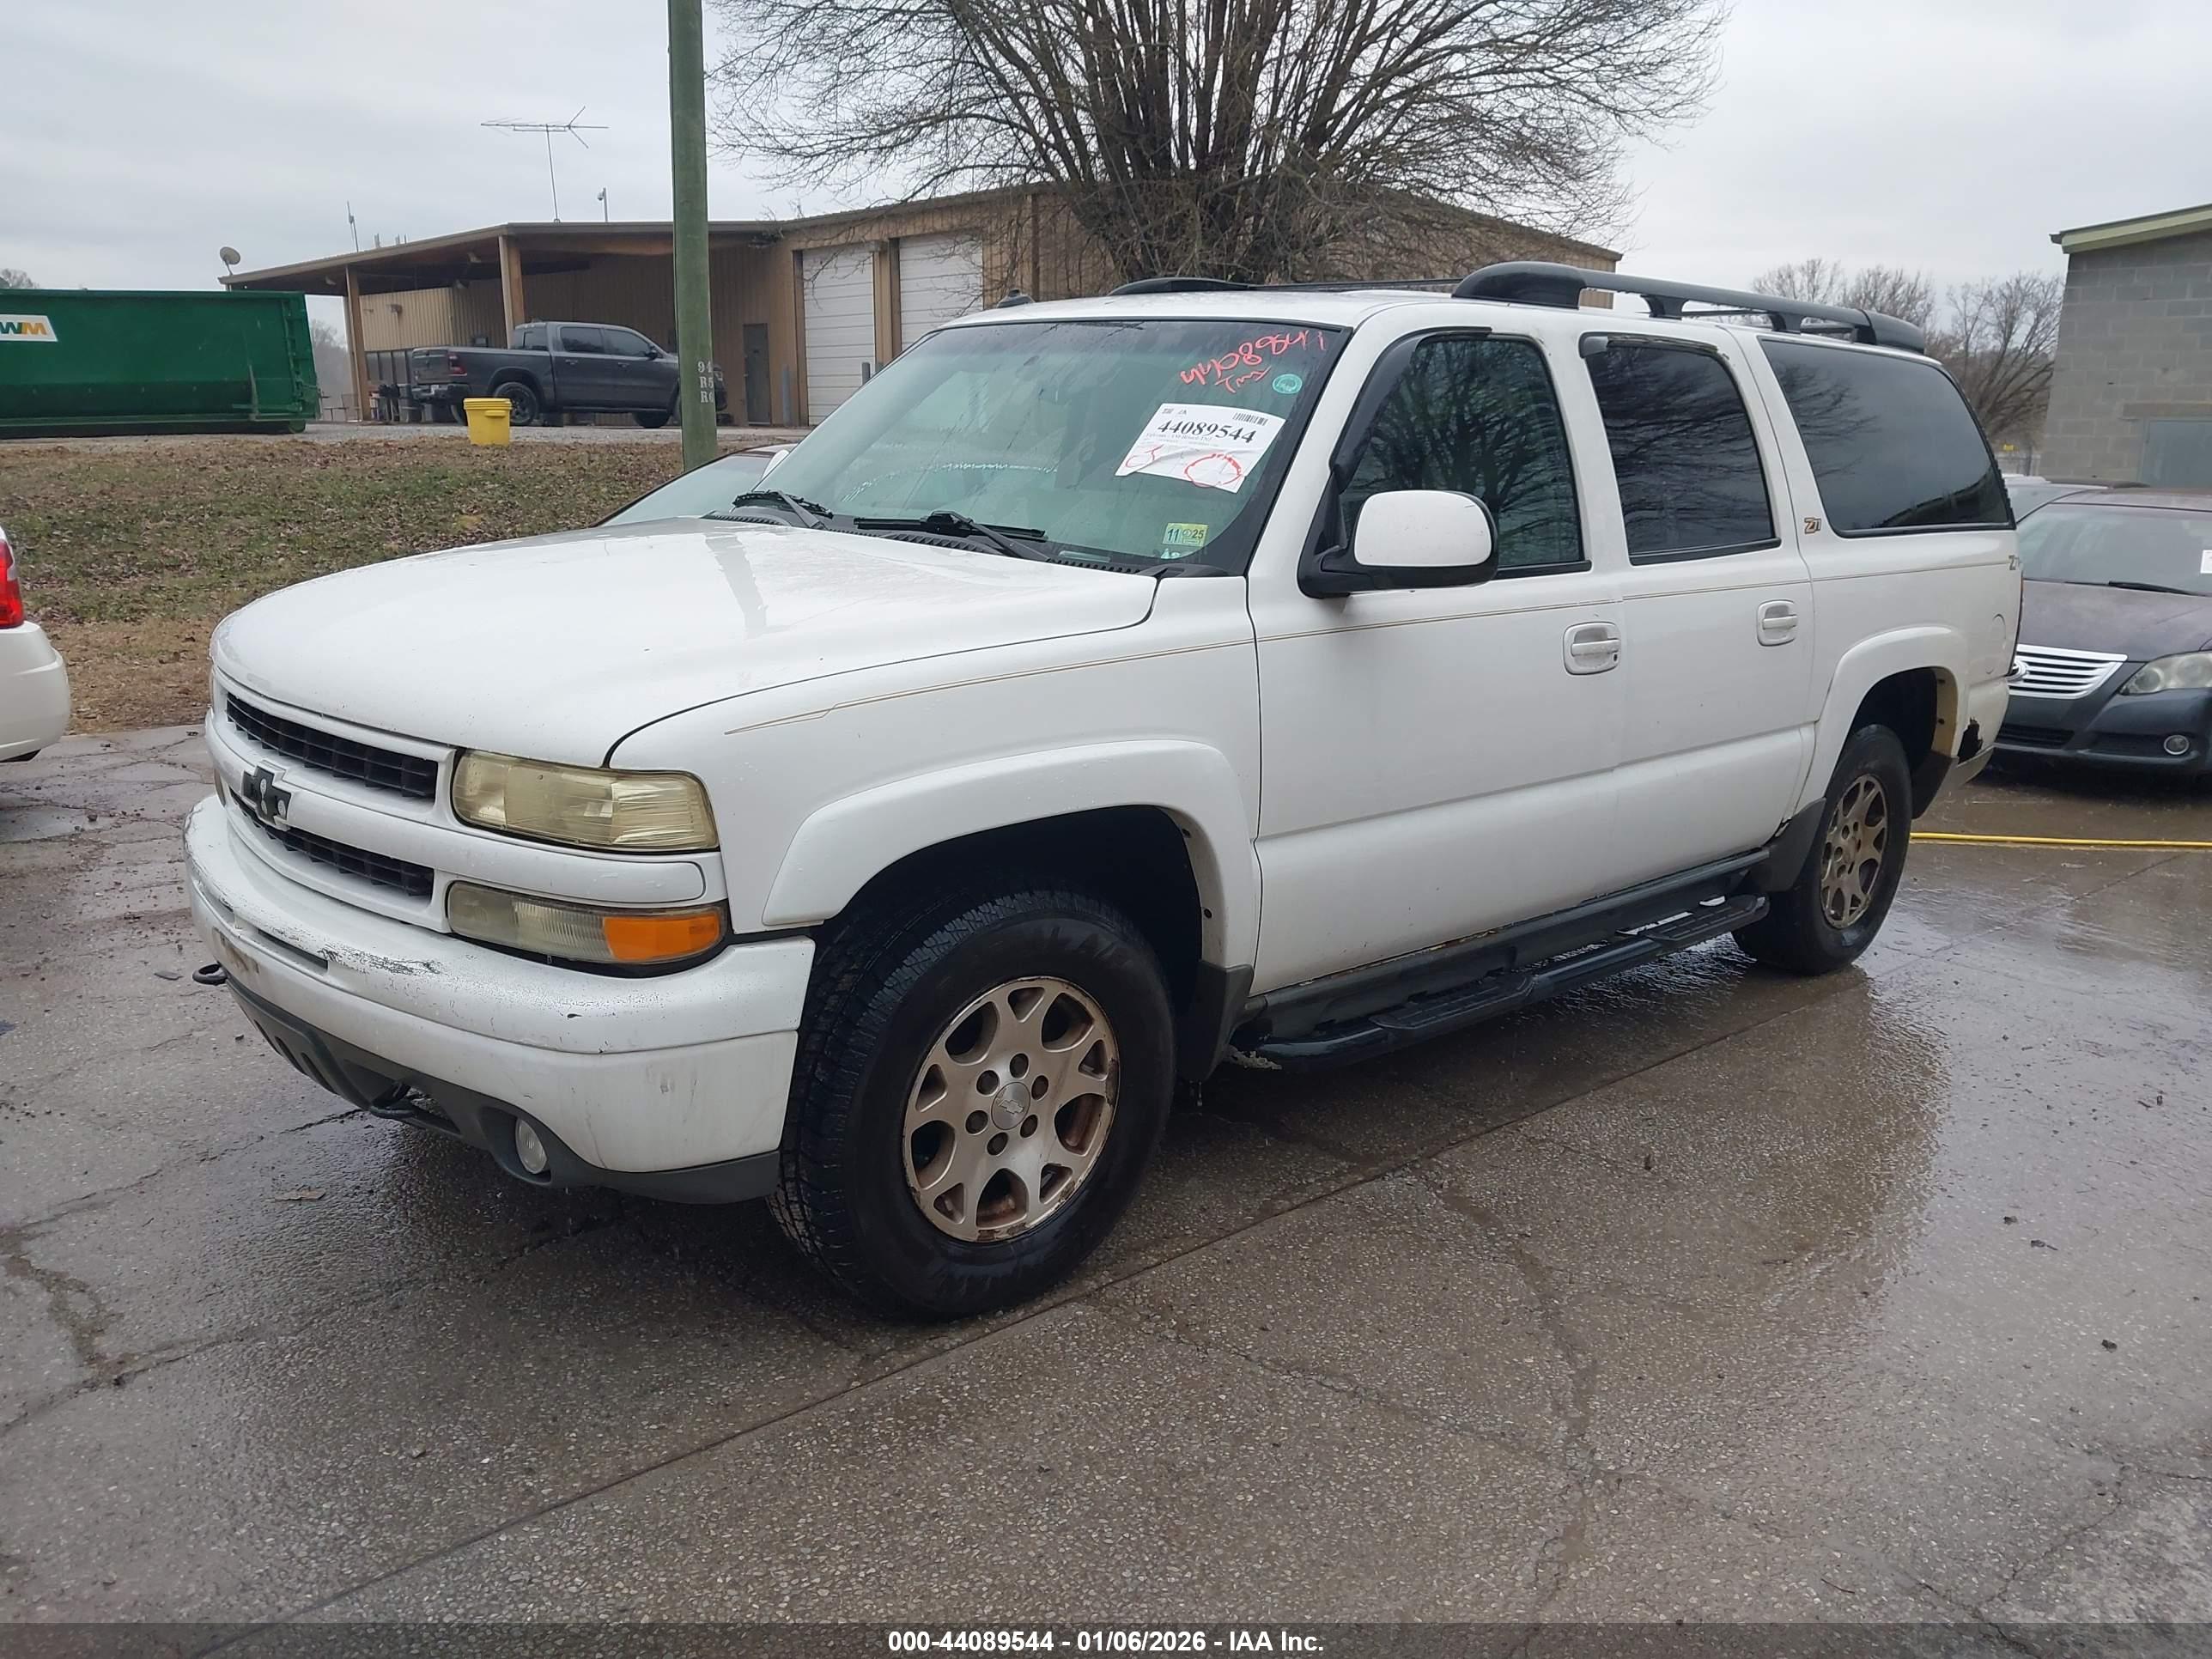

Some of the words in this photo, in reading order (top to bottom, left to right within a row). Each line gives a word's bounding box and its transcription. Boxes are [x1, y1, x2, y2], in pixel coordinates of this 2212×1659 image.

[0, 322, 47, 335] WM
[1157, 419, 1257, 444] 44089544
[1804, 517, 1822, 534] Z71
[1167, 528, 1180, 542] 11
[1192, 529, 1204, 539] 25
[2008, 555, 2021, 571] Z7
